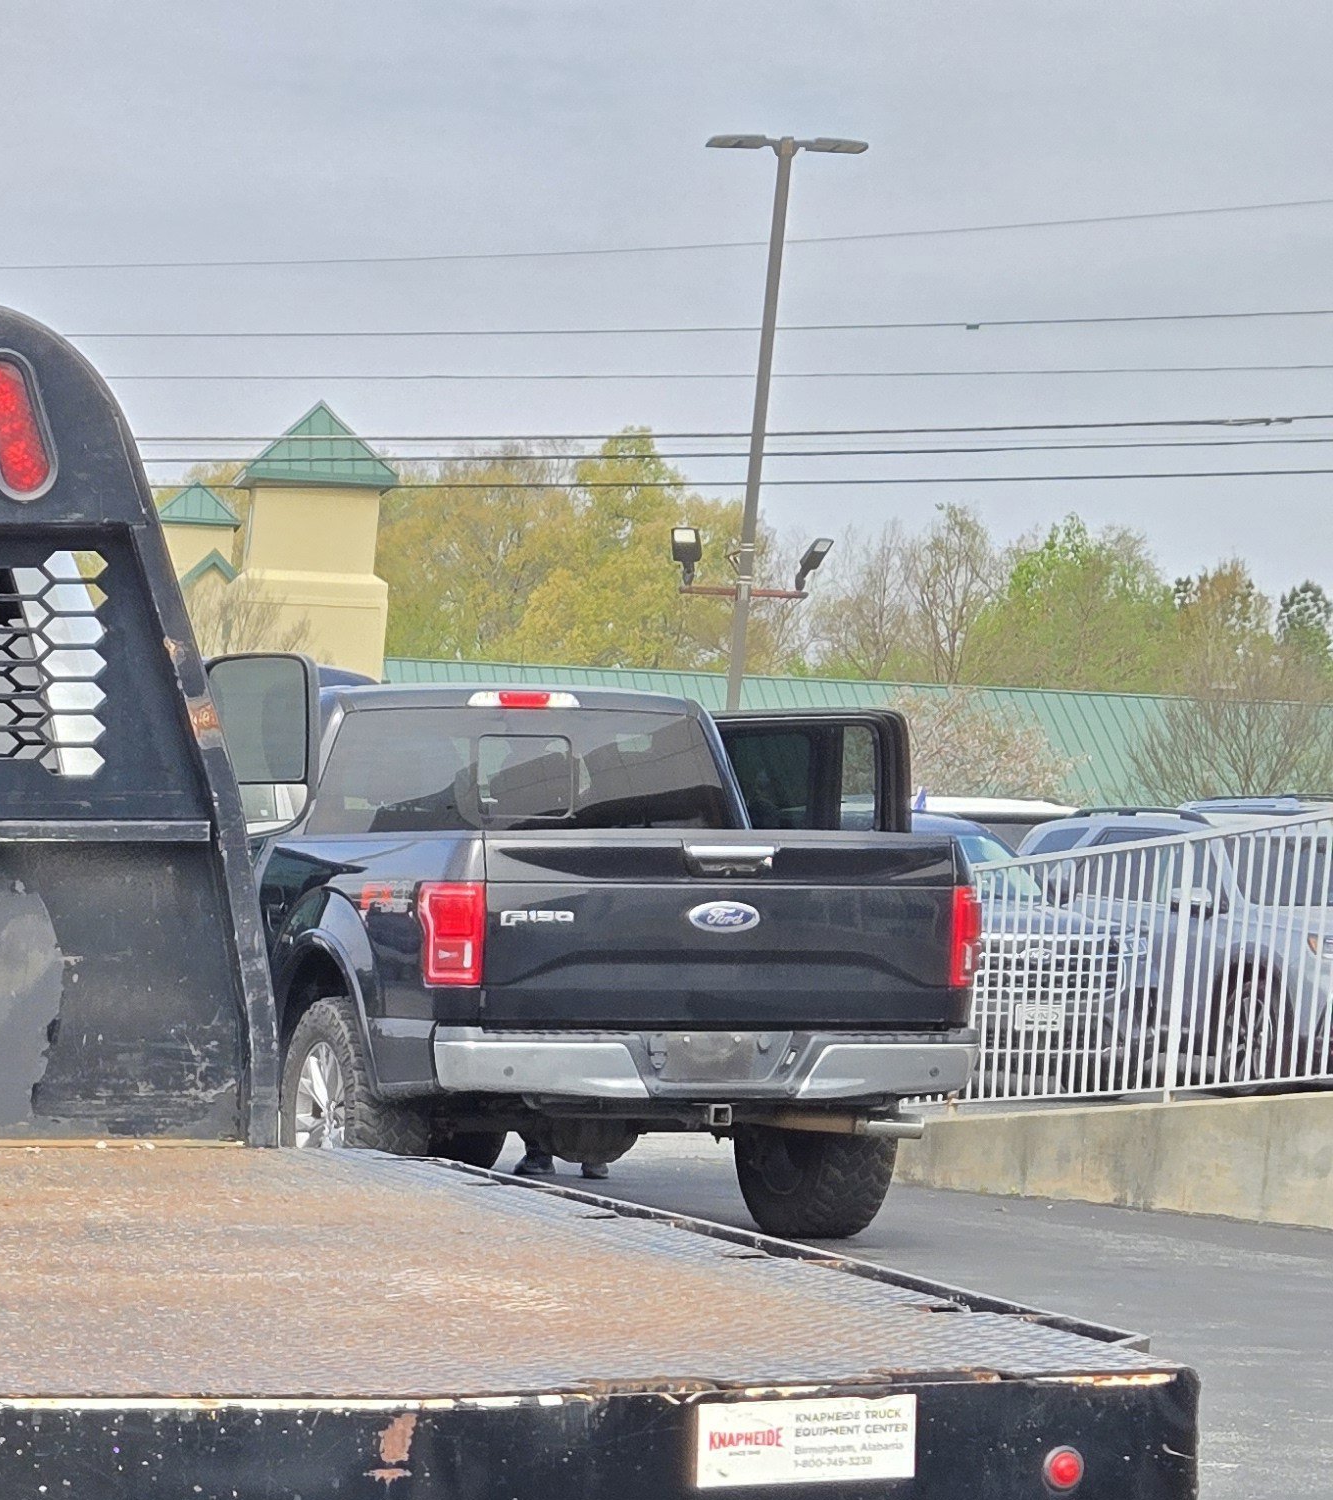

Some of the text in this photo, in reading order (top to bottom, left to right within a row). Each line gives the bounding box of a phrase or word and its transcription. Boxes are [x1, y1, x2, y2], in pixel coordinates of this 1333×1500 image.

[706, 907, 745, 925] Ford
[865, 1409, 902, 1420] TRUCK
[794, 1423, 909, 1438] EQUIPMENT CENTER
[709, 1427, 784, 1451] KNAPHEIDE
